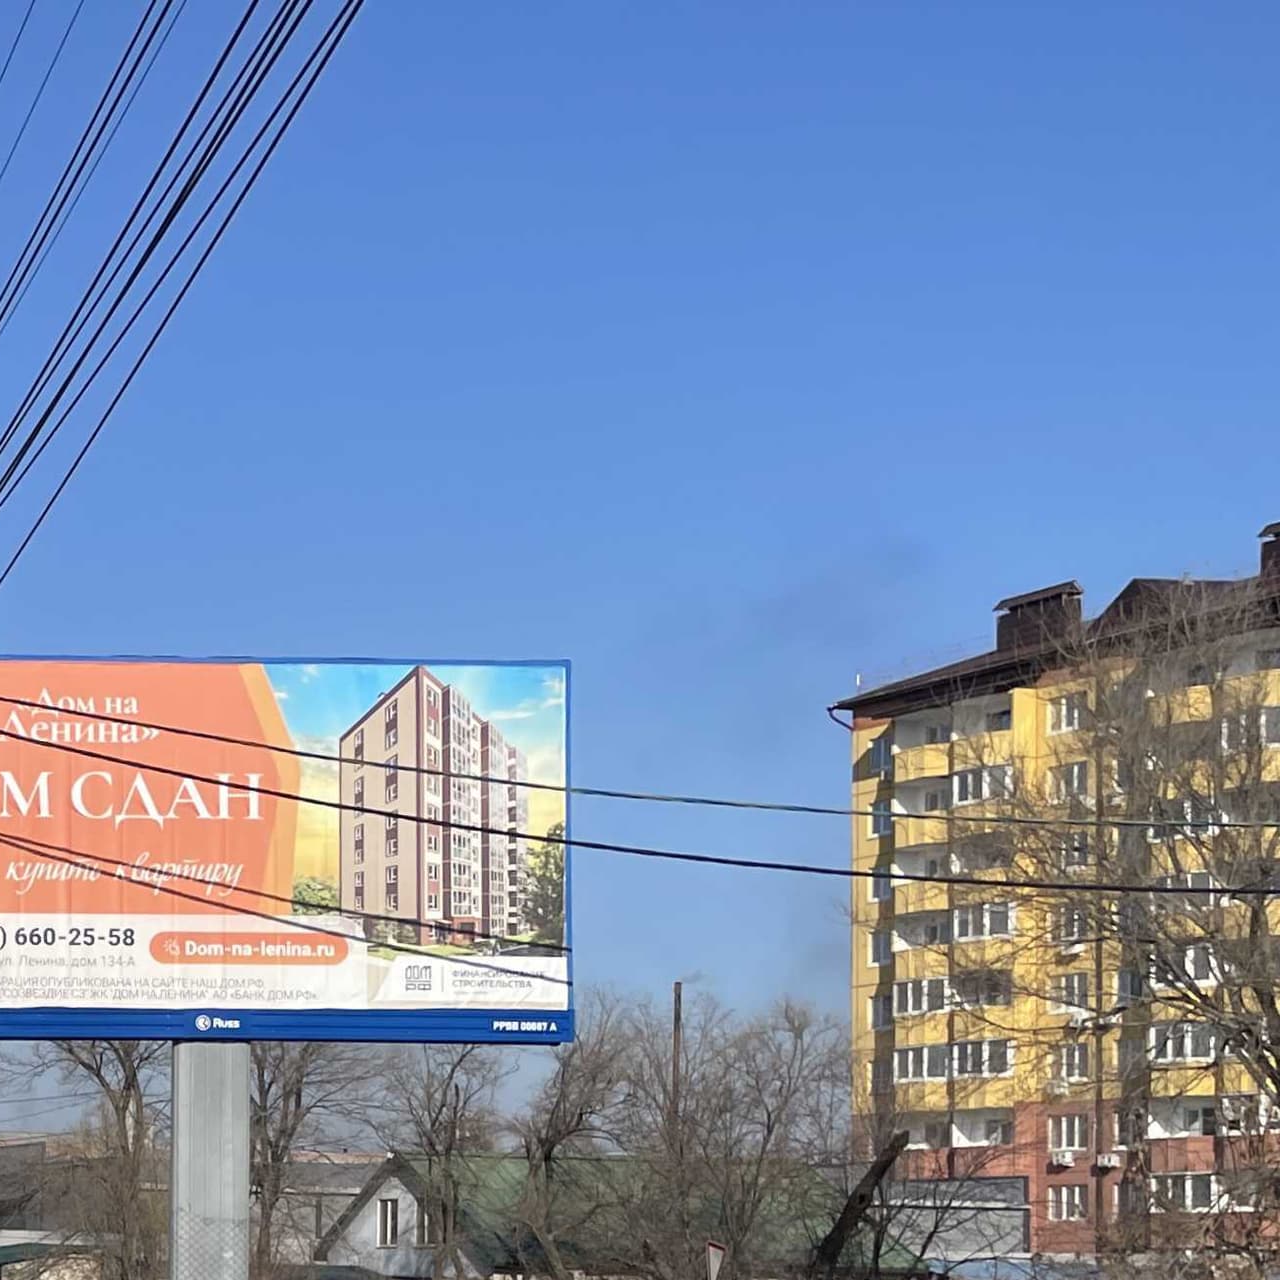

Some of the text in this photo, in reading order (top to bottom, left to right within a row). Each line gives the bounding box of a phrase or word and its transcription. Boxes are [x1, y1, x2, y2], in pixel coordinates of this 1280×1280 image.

[104, 699, 138, 714] на
[70, 771, 264, 831] СДАН
[5, 858, 101, 896] купить
[115, 851, 244, 896] квартиру
[14, 927, 135, 947] 660-25-58
[184, 940, 335, 957] Dom-na-lenina.ru
[71, 957, 97, 967] дом
[452, 980, 532, 989] СТРОИТЕЛЬСТВА
